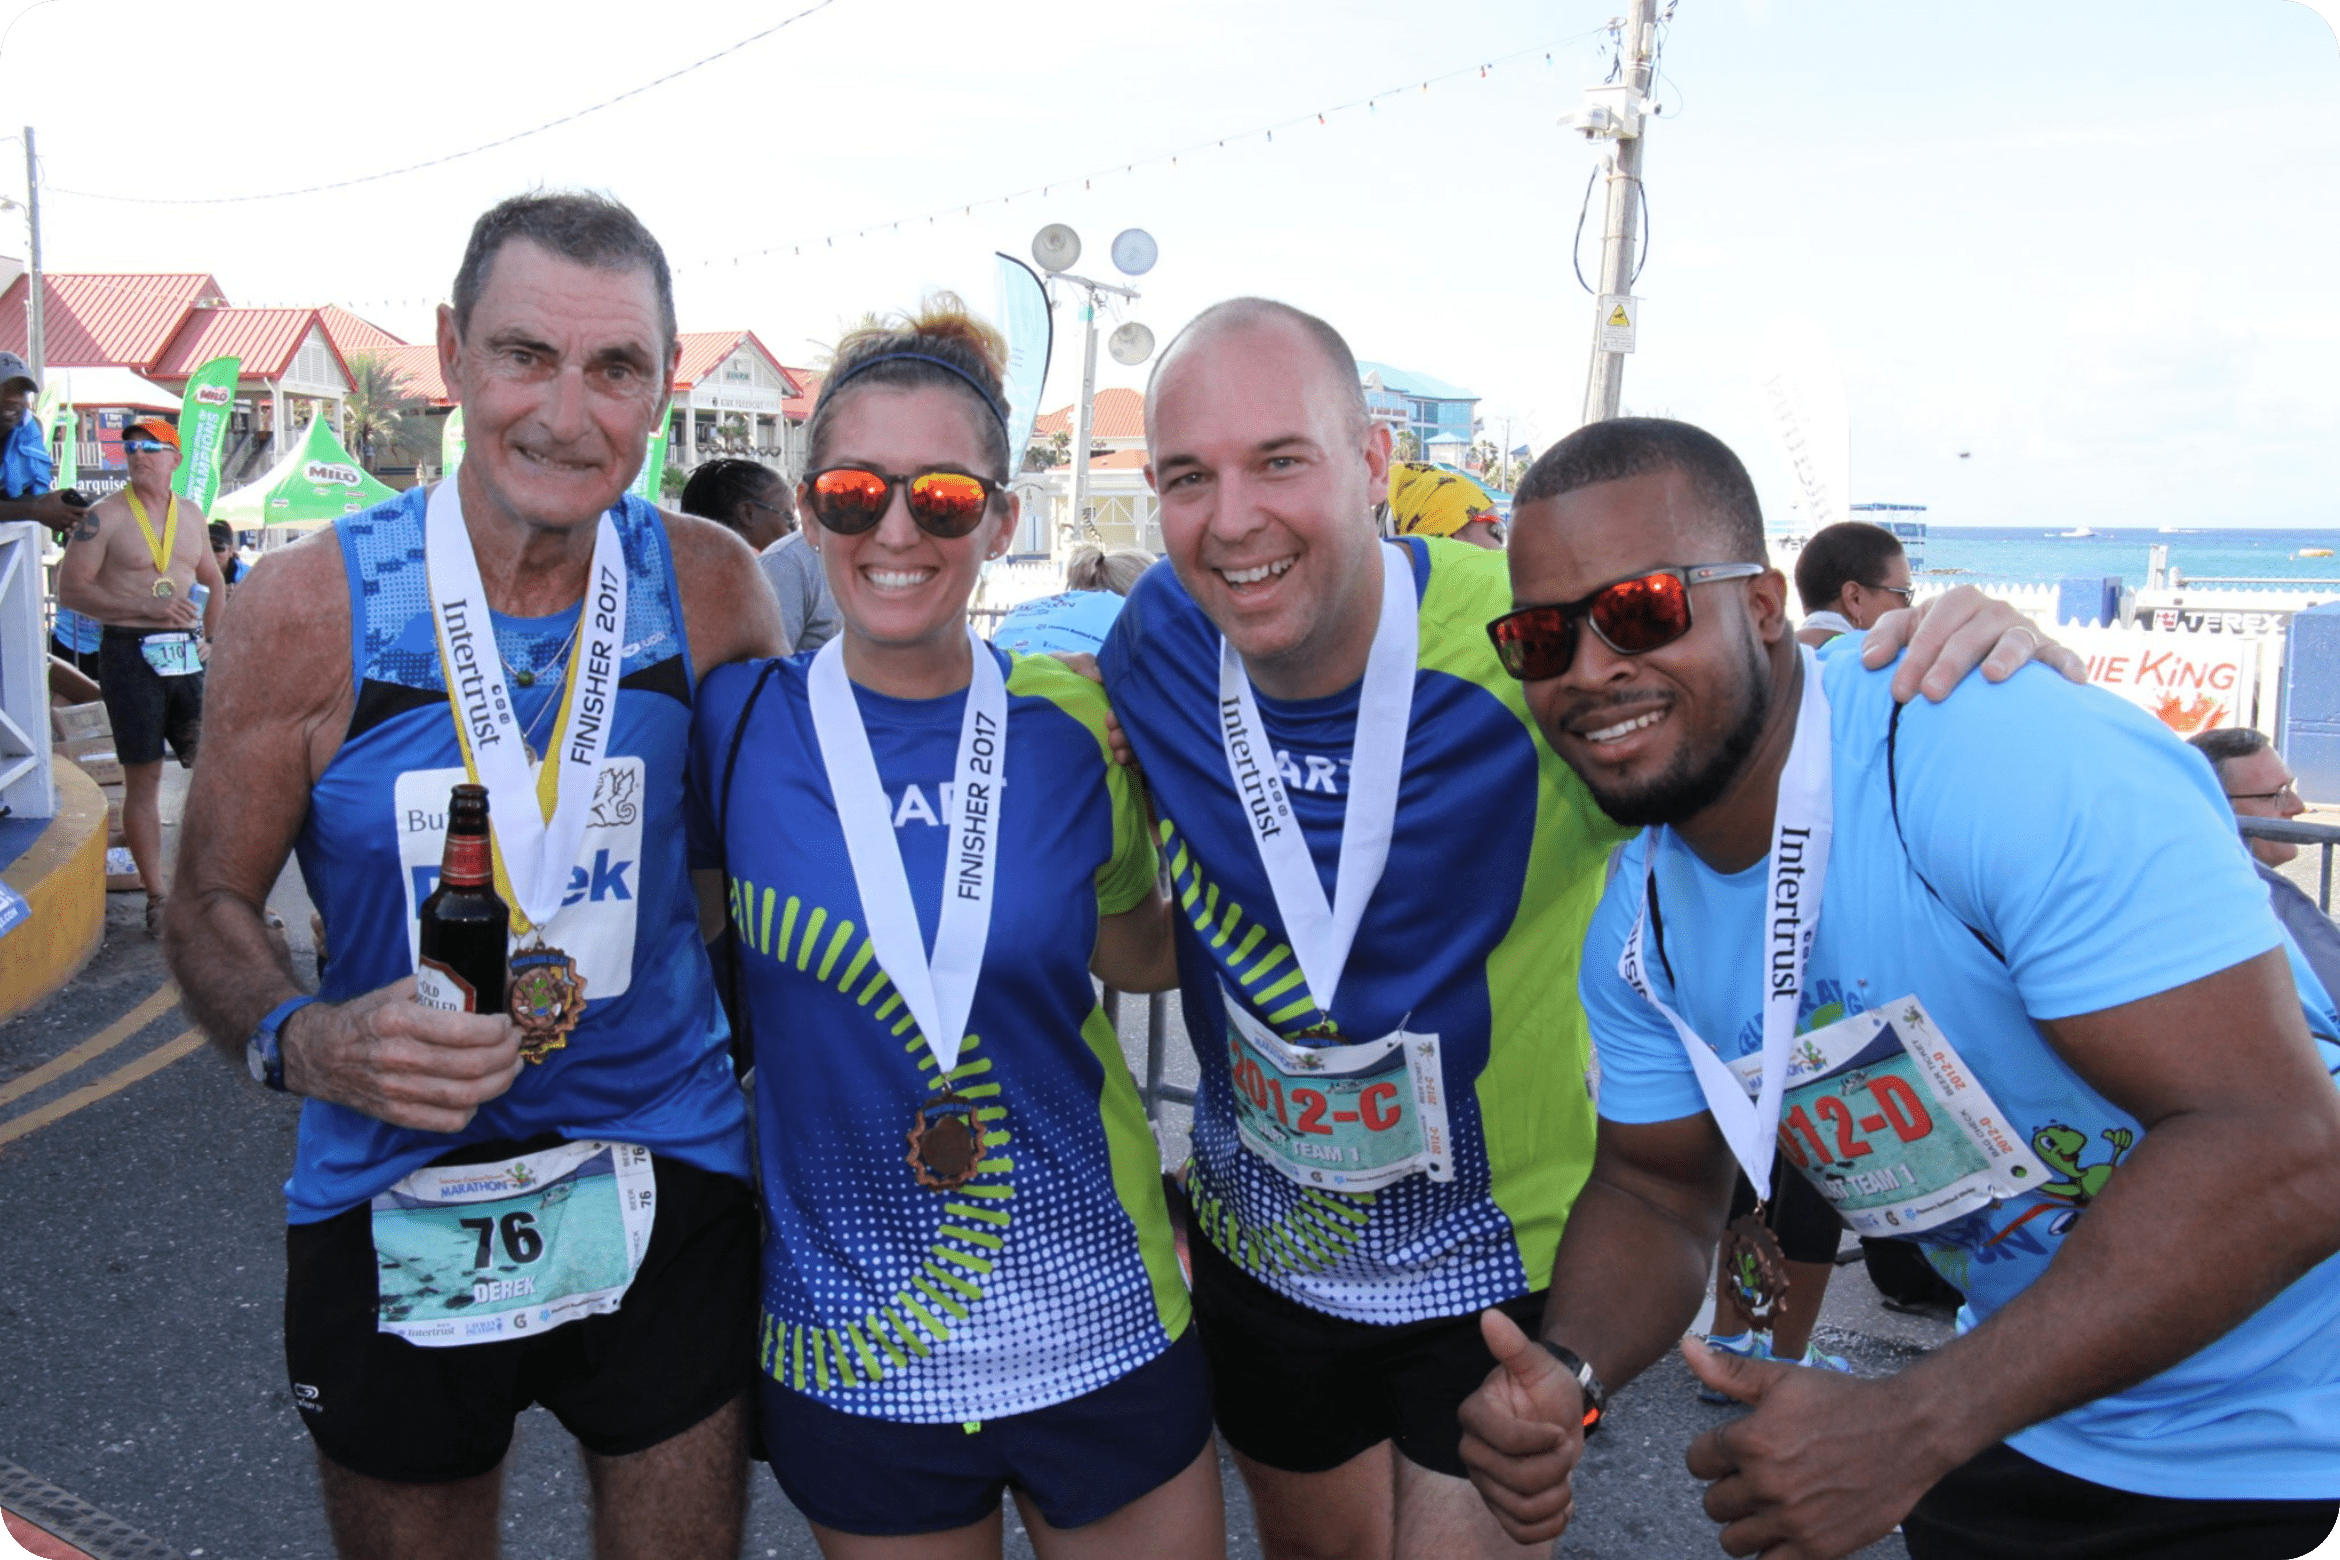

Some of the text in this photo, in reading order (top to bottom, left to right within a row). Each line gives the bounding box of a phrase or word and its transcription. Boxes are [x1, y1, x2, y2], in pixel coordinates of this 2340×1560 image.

[309, 466, 358, 482] MILO
[2184, 612, 2284, 635] TEREX
[442, 598, 501, 750] Intertrust
[571, 565, 619, 766] FINISHER 2017
[1221, 695, 1282, 843] Intertrust
[957, 710, 997, 901] FINISHER 2017
[1772, 825, 1811, 1002] Intertrust
[1911, 1039, 1954, 1097] BEER TICKET
[1933, 1051, 1967, 1090] 2012-D
[1229, 1038, 1402, 1136] 2012-C
[1960, 1109, 1985, 1139] CHECK
[1979, 1117, 2014, 1154] 2012-D
[632, 1146, 647, 1166] 76
[1293, 1141, 1344, 1162] TEAM
[1349, 1147, 1361, 1162] 1
[440, 1180, 509, 1199] MARATHON
[1846, 1168, 1901, 1197] TEAM
[1899, 1163, 1917, 1184] 1
[639, 1190, 652, 1210] 76
[459, 1211, 546, 1271] 76
[474, 1276, 537, 1305] DEREK
